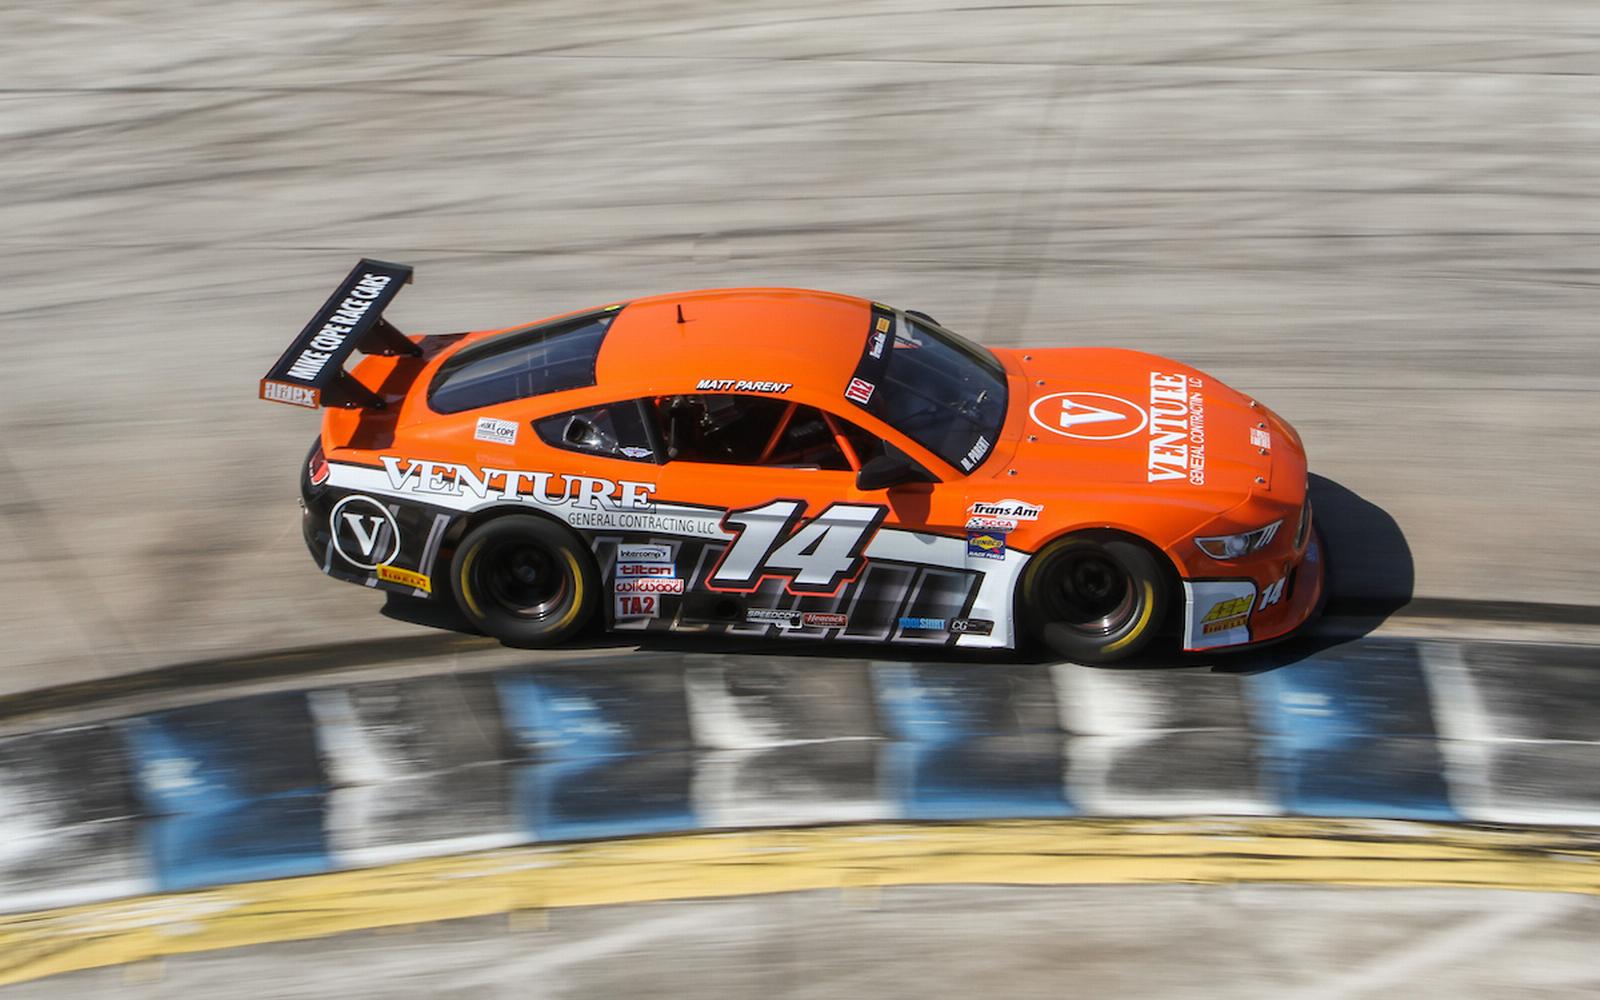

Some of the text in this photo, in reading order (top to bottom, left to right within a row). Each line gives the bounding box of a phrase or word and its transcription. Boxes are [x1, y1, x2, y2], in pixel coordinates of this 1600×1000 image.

[356, 273, 392, 300] CARS
[330, 298, 371, 326] RACE
[310, 324, 351, 351] COPE
[287, 349, 332, 380] MIKE
[696, 379, 792, 394] MATT PARENT
[848, 379, 874, 402] TA2
[1060, 399, 1127, 428] V
[379, 455, 656, 514] VENTURE
[974, 503, 1038, 517] Trans Am
[342, 512, 385, 556] V
[568, 511, 715, 535] GENERAL CONTRACTING LLC
[983, 519, 1013, 527] SCCA
[620, 549, 662, 559] Intercomp
[707, 499, 886, 594] 14
[620, 565, 672, 575] tilton
[616, 579, 684, 593] wilwood
[1258, 576, 1287, 611] 14
[620, 596, 655, 615] TA2
[951, 620, 969, 631] CG
